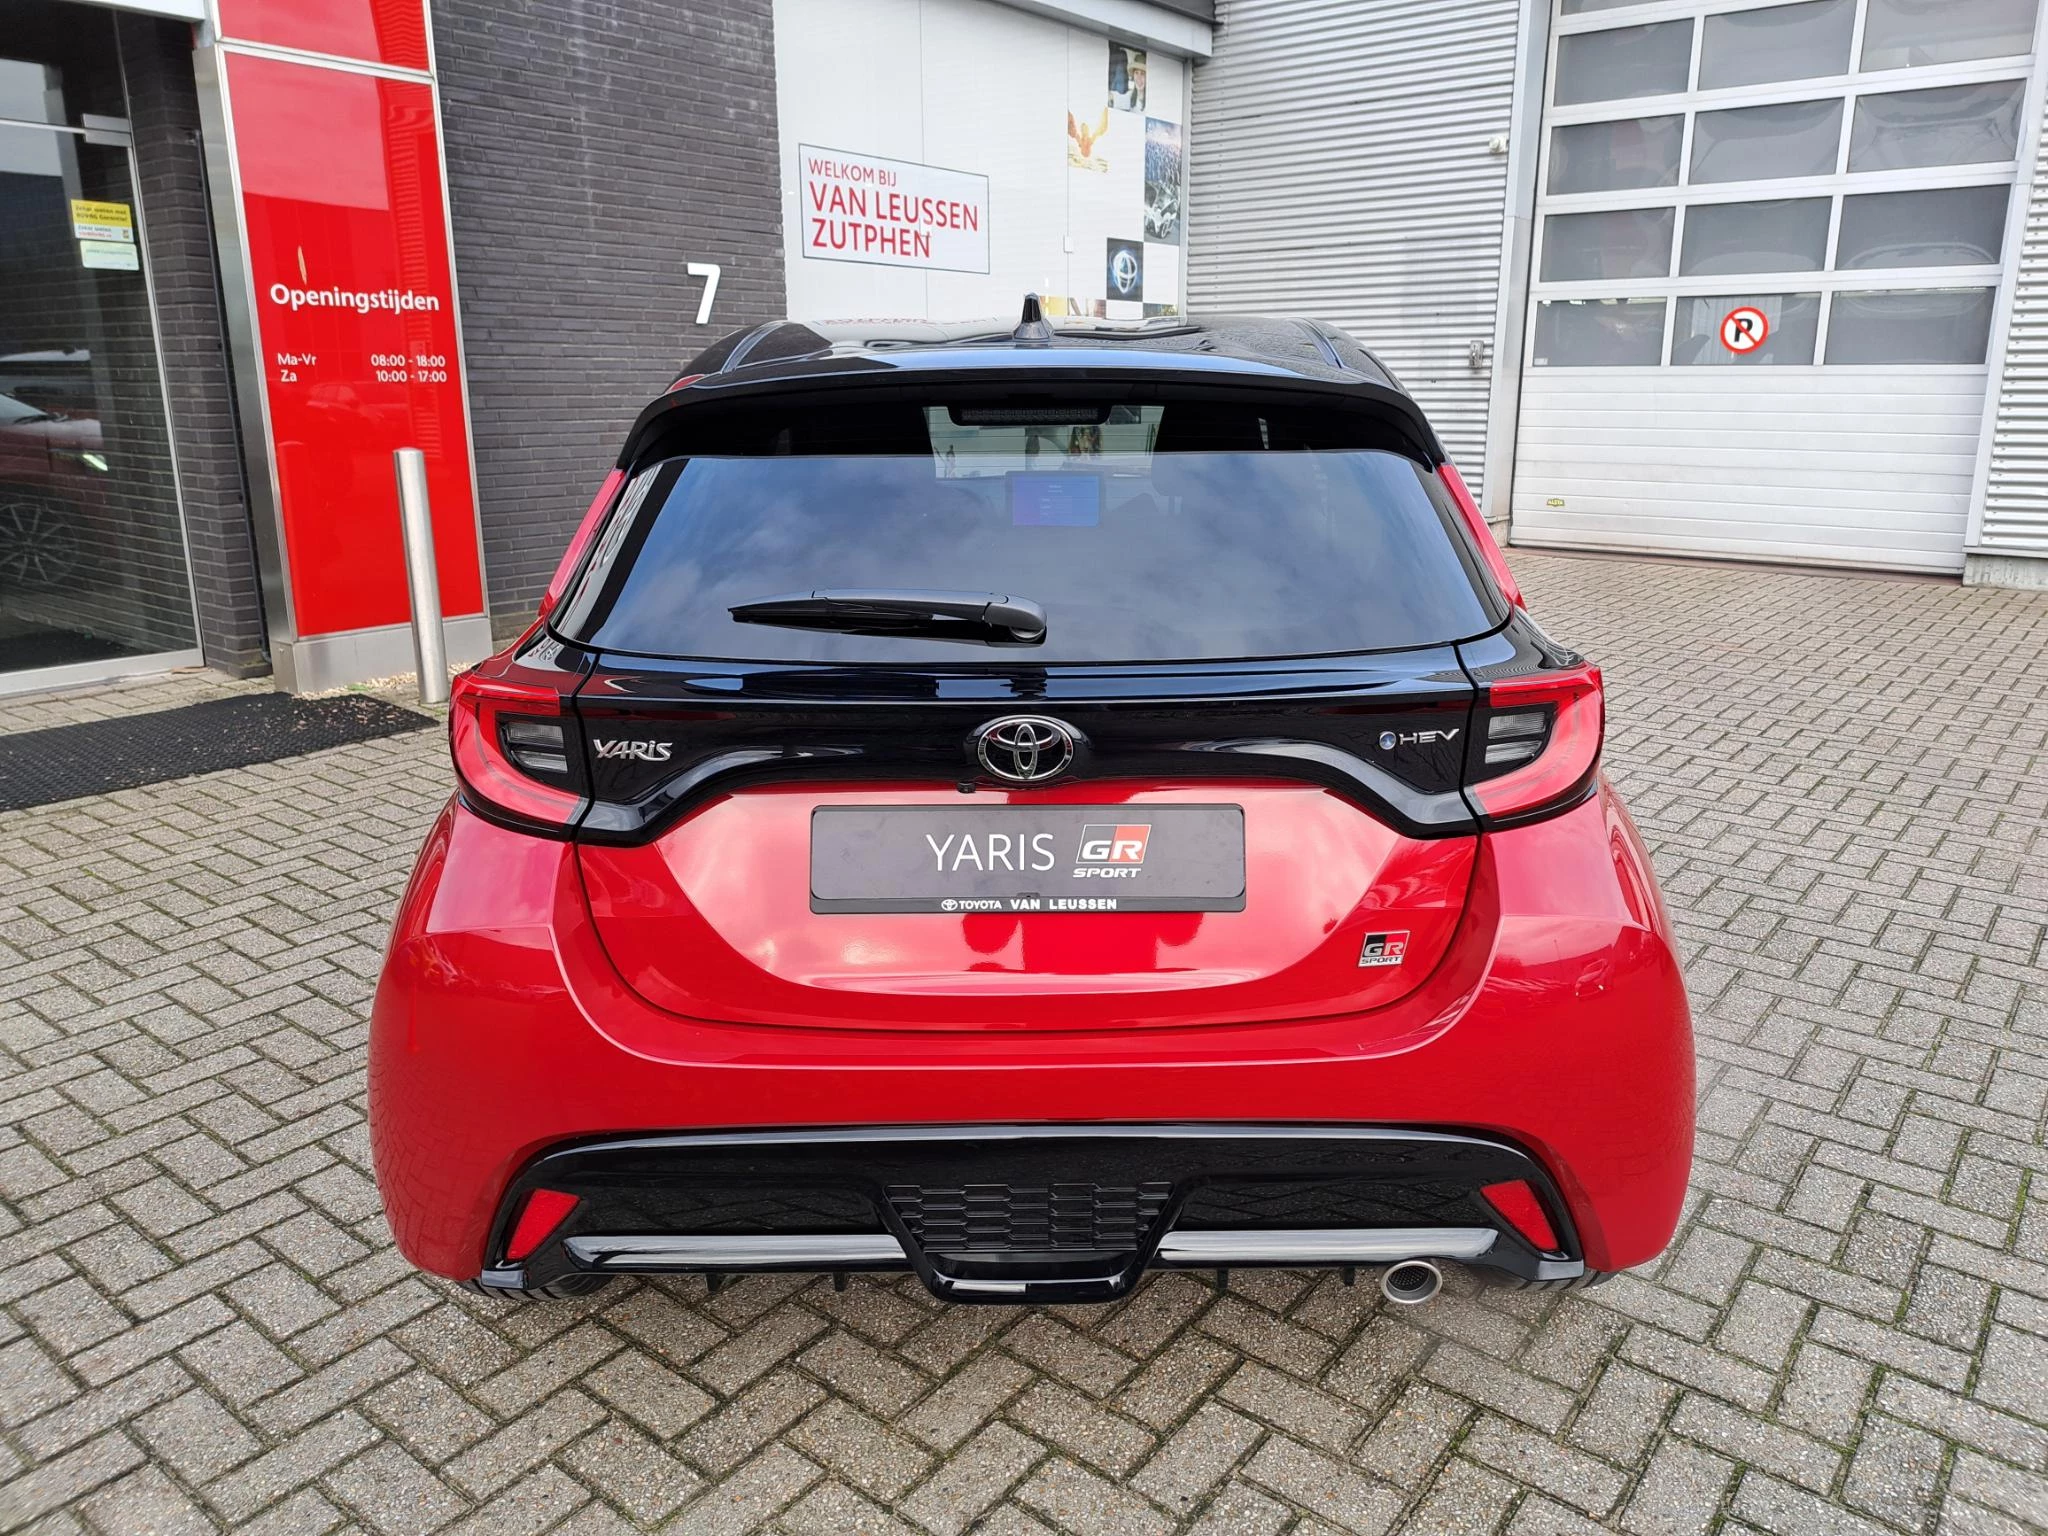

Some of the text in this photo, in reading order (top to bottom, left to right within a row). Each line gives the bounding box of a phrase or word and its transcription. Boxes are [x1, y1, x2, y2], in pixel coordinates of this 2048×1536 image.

[808, 157, 897, 187] WELKOM BIJ
[809, 181, 978, 231] VAN LEUSSEN
[812, 218, 930, 258] ZUTPHEN
[270, 283, 440, 315] Openingstijden
[687, 262, 721, 324] 7
[277, 352, 317, 366] Ma-Vr
[371, 354, 405, 367] 08:00
[416, 355, 446, 368] 18:00
[280, 369, 297, 383] Za
[376, 370, 407, 383] 10:00
[418, 371, 447, 383] 17:00
[1399, 729, 1460, 746] HEV
[926, 834, 1055, 871] YARIS
[1082, 840, 1143, 860] GR
[1072, 867, 1142, 878] SPORT
[958, 899, 1117, 910] TOYOTA VAN LEUSSEN
[1364, 942, 1404, 957] GR
[1361, 956, 1402, 965] SPORT
